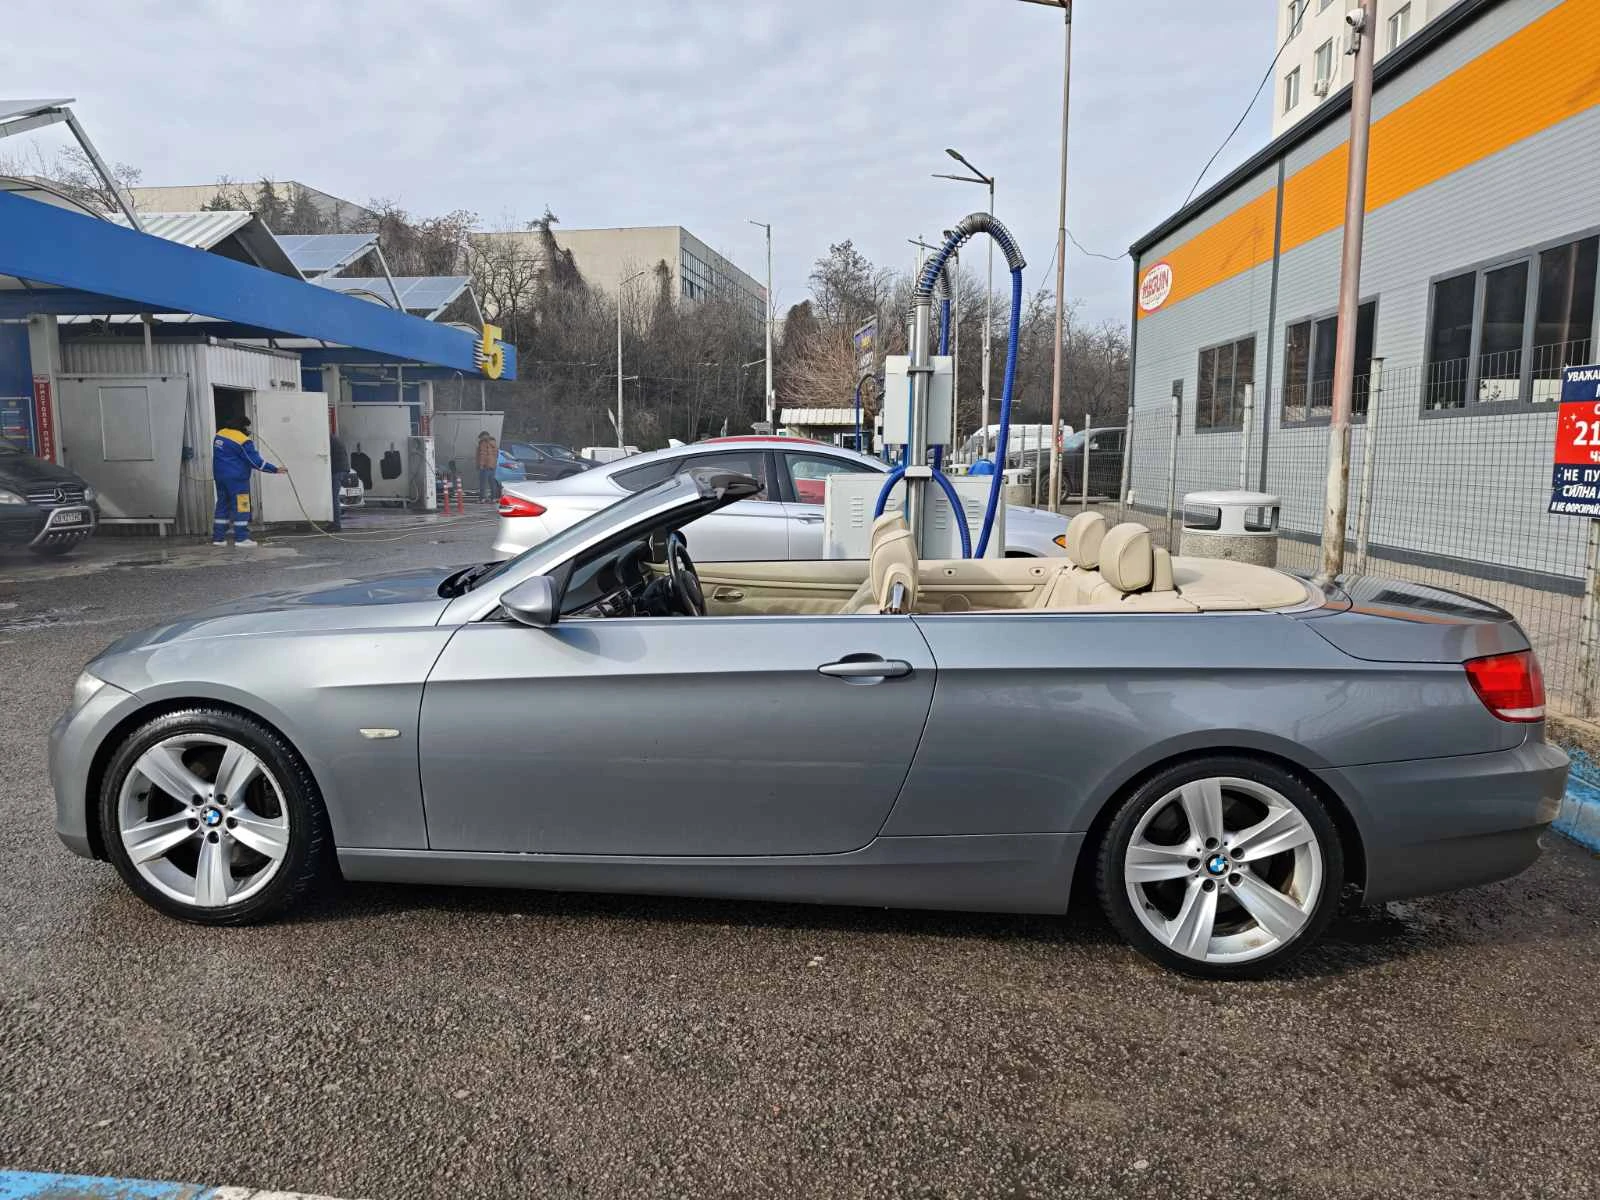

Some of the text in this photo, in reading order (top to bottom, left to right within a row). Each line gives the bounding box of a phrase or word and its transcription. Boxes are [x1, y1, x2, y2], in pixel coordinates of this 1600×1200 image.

[482, 323, 503, 380] 5
[1563, 469, 1579, 481] НЕ
[1562, 484, 1597, 499] СИЛНА
[1551, 501, 1557, 511] И
